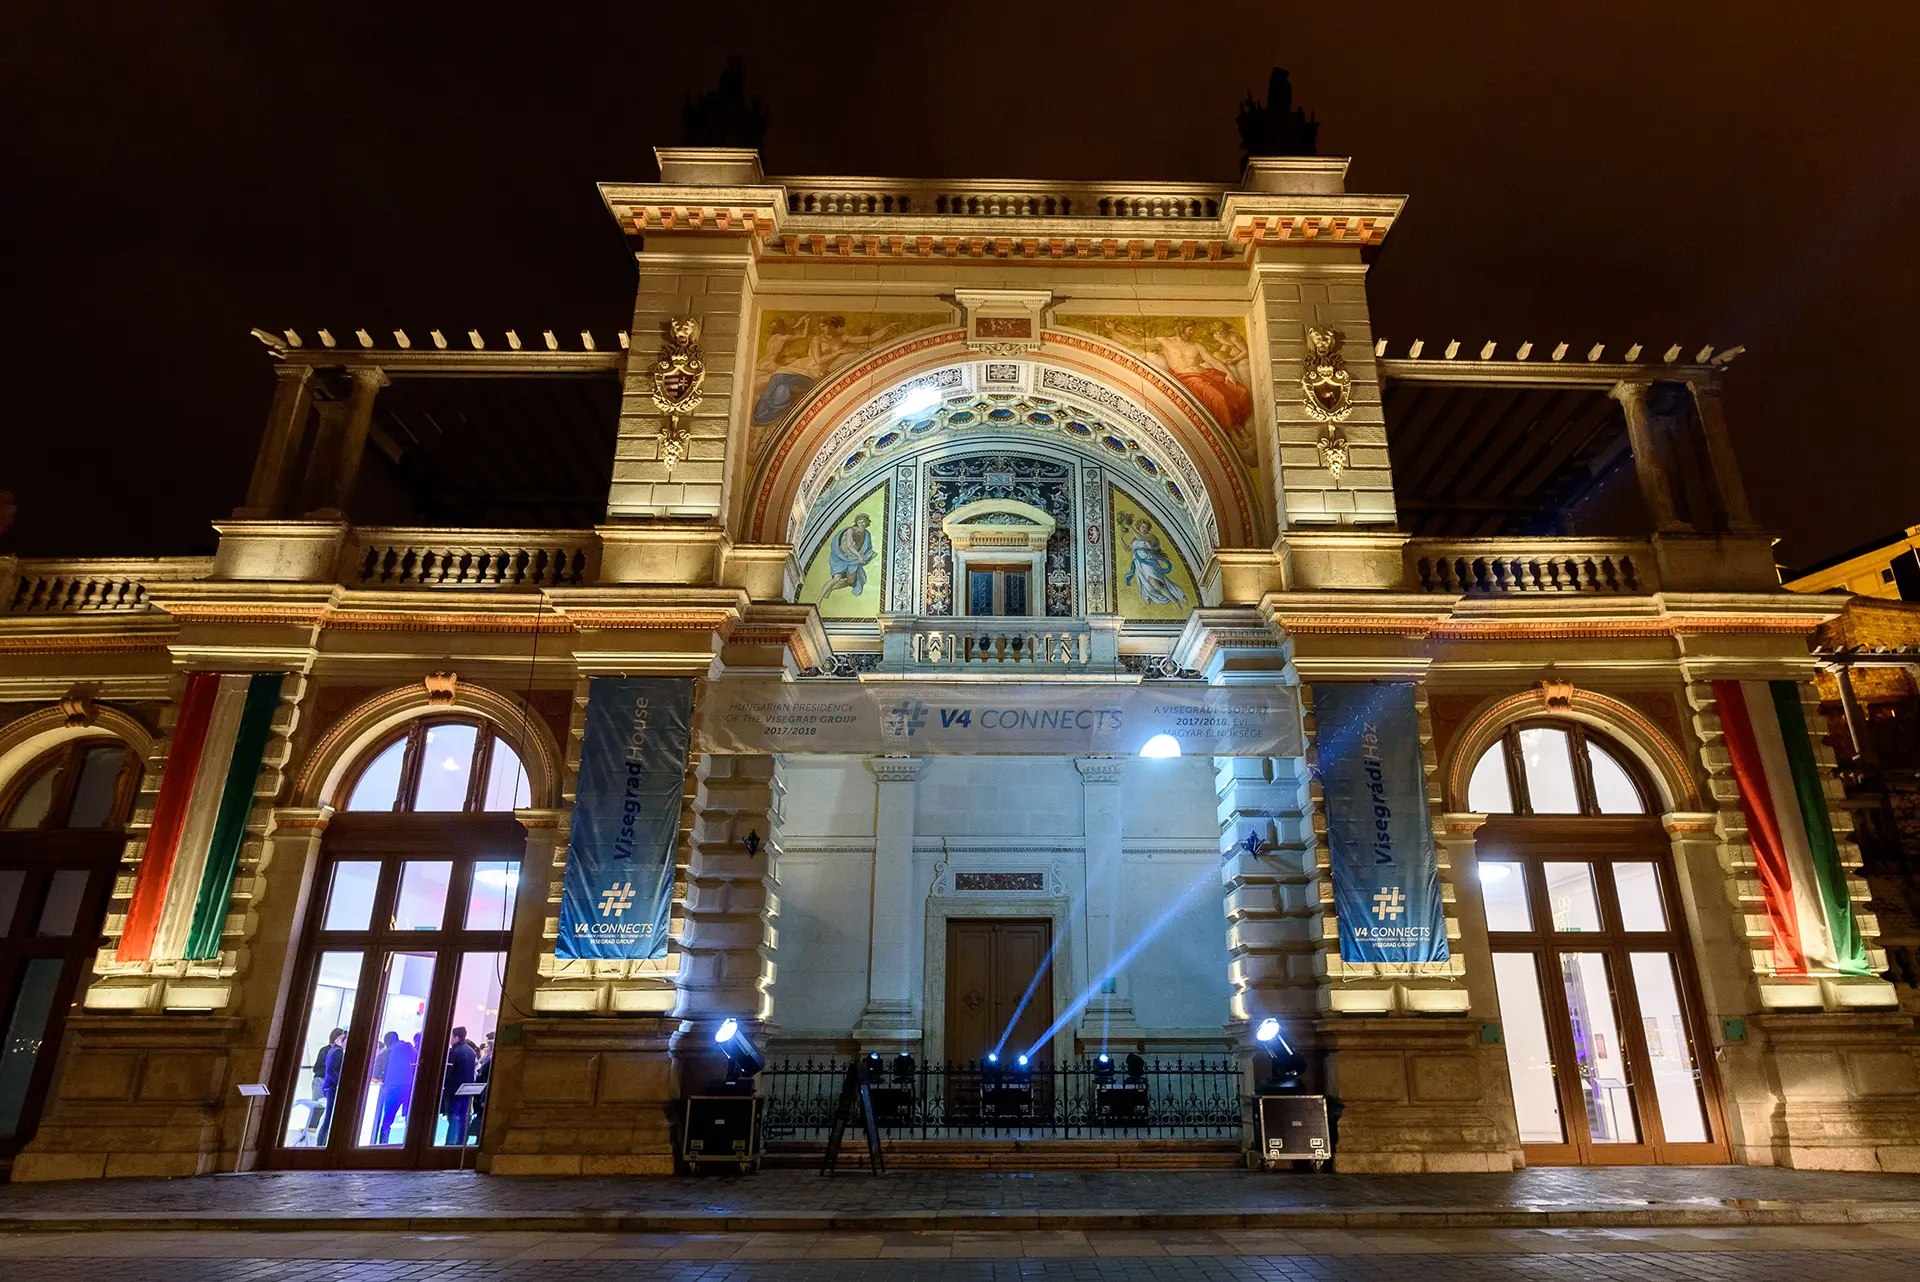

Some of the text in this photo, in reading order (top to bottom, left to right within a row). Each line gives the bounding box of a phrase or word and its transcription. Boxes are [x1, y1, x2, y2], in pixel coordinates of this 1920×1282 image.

[730, 703, 855, 712] HUNGARIAN PRESIDENCY
[1220, 705, 1269, 714] CSOPORT
[765, 714, 817, 724] VISEGRAD
[819, 715, 857, 724] GROUP
[940, 708, 1123, 729] V4 CONNECTS
[763, 726, 817, 736] 2017/2018
[574, 923, 654, 934] V4 CONNECTS
[1354, 927, 1430, 937] V4 CONNECTS
